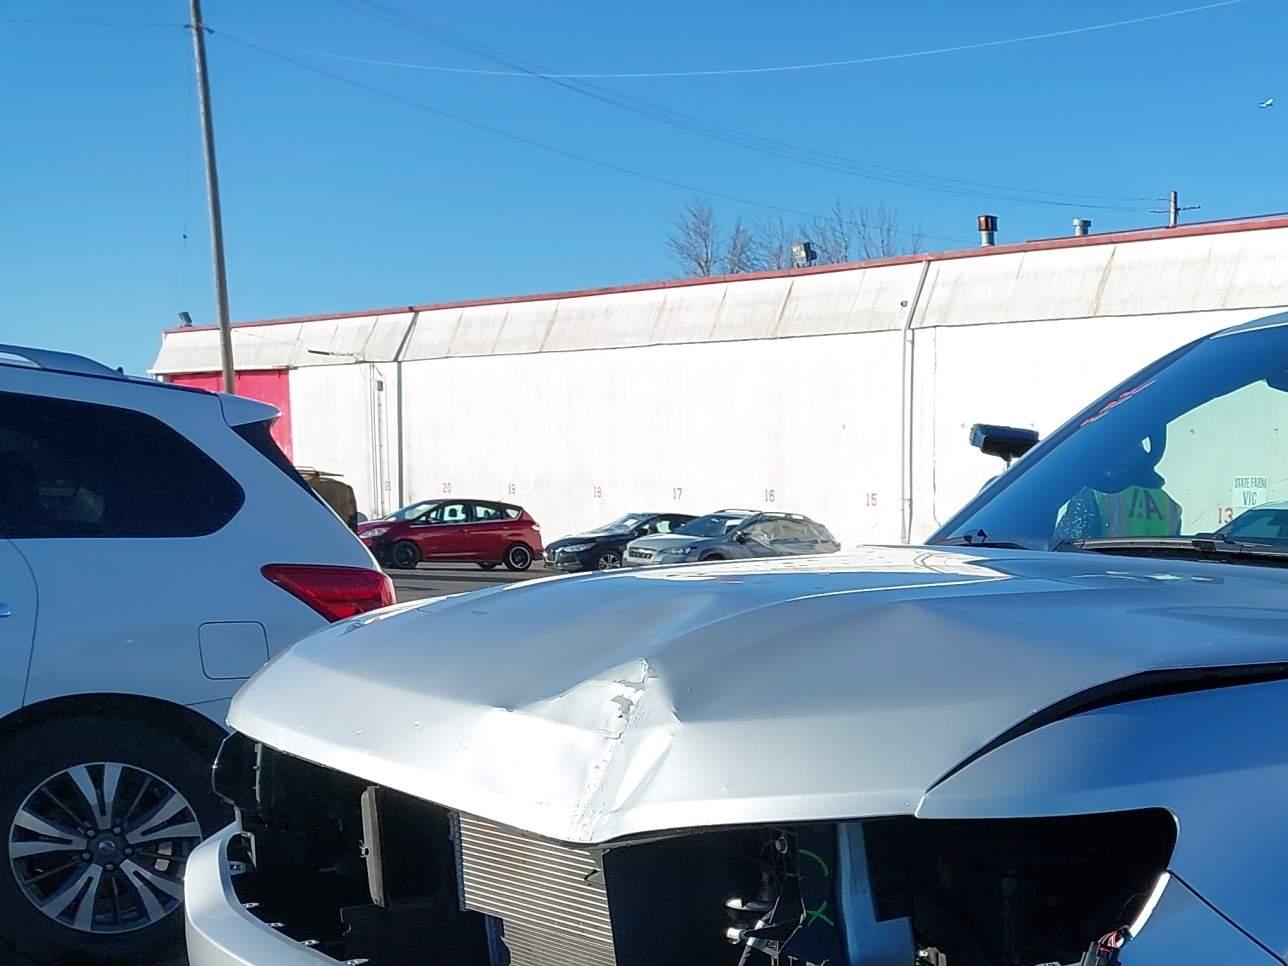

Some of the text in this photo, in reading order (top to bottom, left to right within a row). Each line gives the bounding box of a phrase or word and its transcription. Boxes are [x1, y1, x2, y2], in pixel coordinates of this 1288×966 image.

[1234, 477, 1250, 489] STATE
[673, 488, 683, 500] 17
[764, 488, 775, 502] 16
[865, 492, 878, 507] 15
[1242, 490, 1258, 506] VIC
